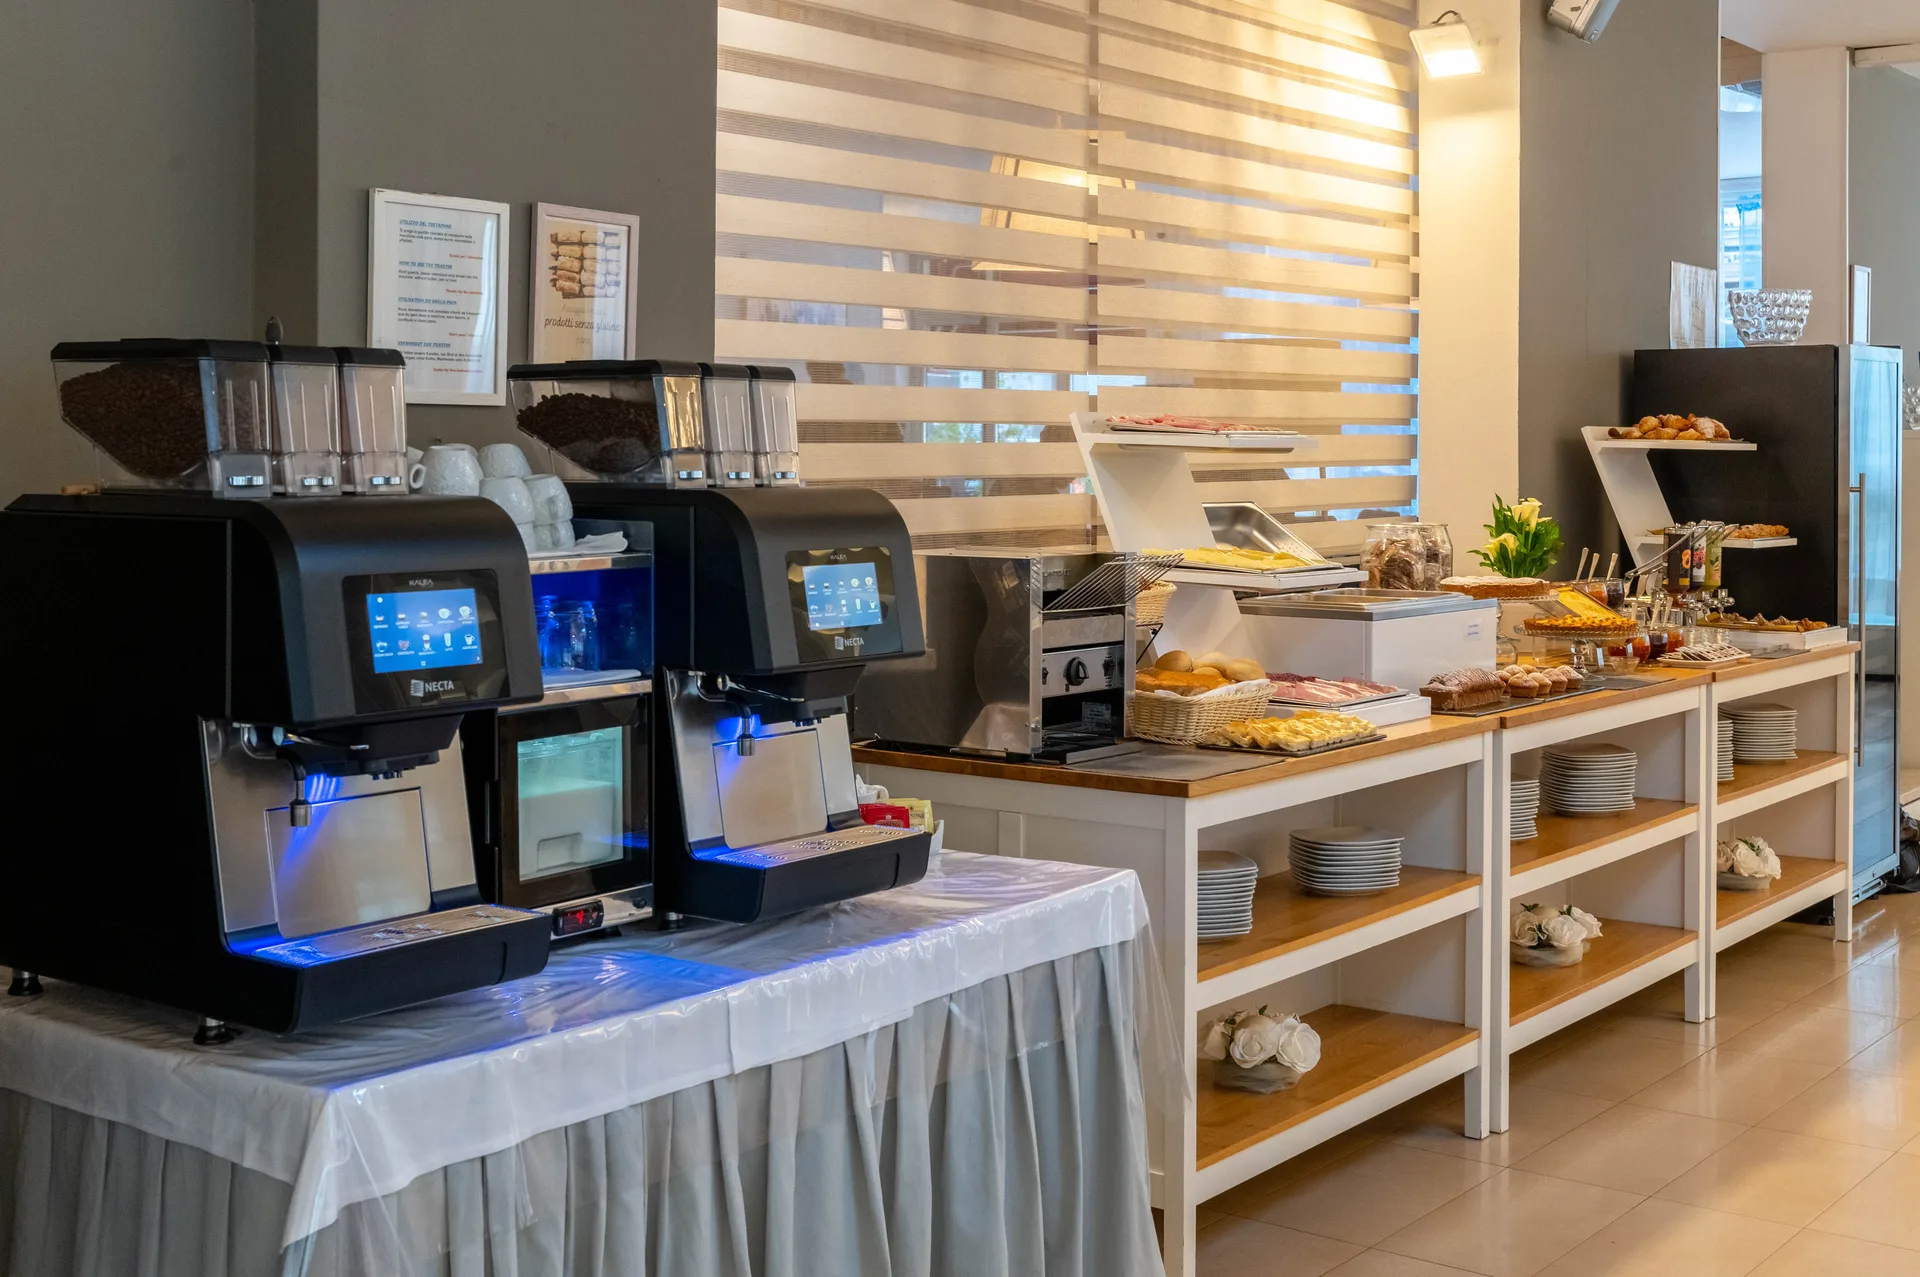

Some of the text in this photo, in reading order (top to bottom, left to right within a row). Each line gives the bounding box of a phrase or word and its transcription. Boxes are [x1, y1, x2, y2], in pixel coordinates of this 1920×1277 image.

[544, 317, 621, 333] prodotti senza glutine
[844, 637, 864, 646] NECTA
[425, 680, 454, 692] NECTA
